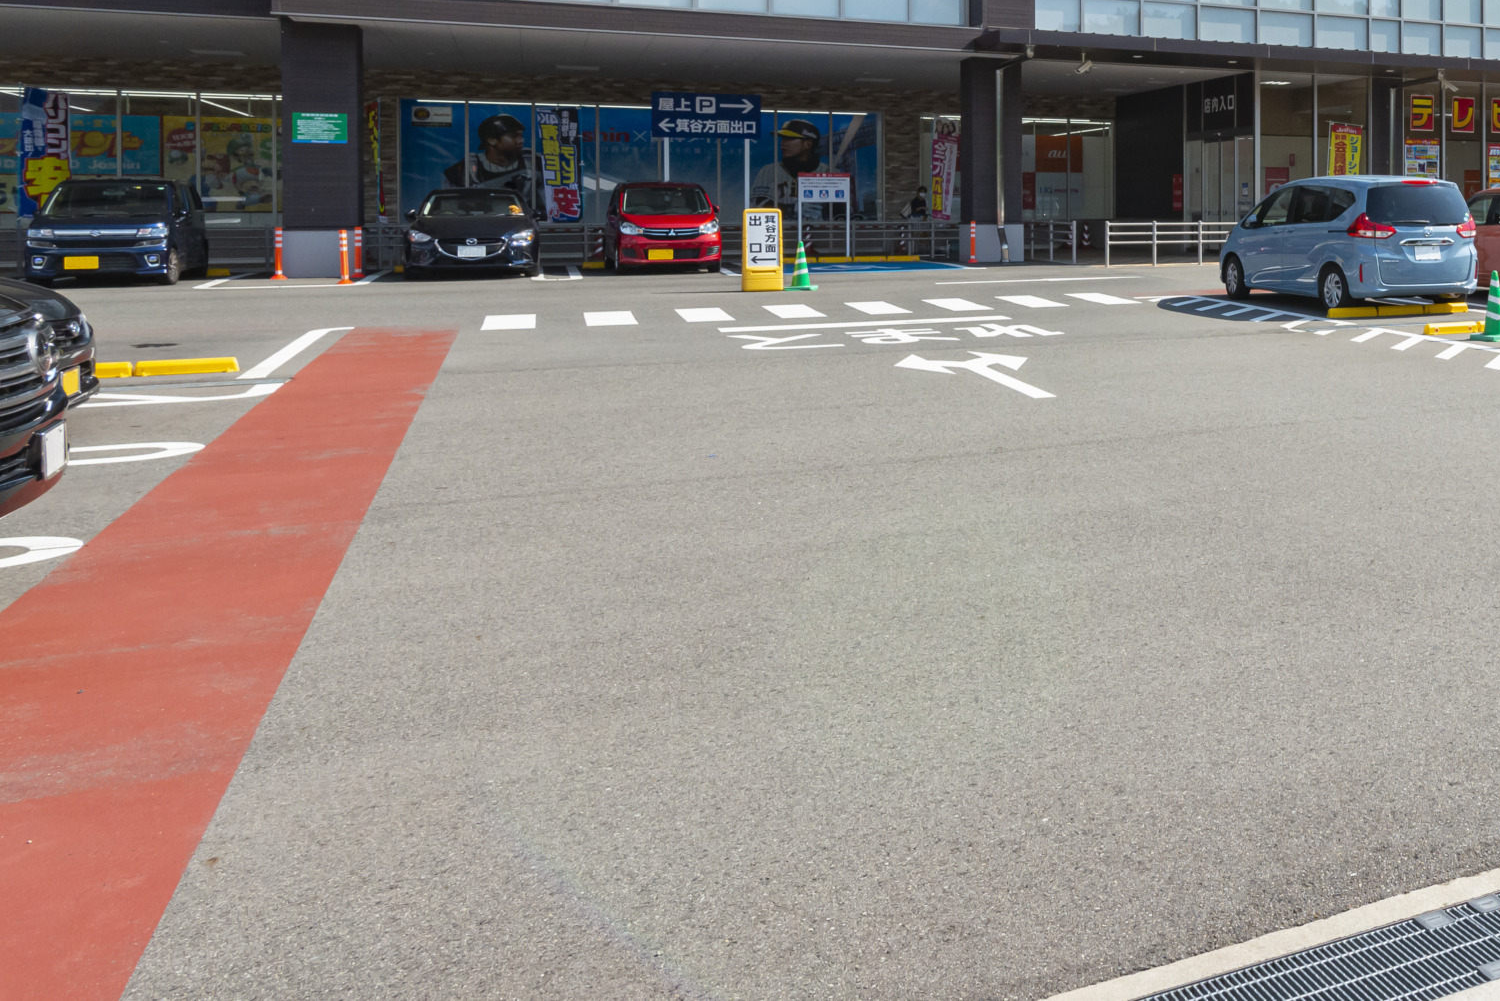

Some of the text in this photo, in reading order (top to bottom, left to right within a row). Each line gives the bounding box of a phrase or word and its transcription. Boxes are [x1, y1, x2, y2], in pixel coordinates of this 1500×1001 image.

[658, 97, 691, 112] 屋上
[1204, 94, 1235, 114] 店内入口
[185, 121, 228, 132] SPER
[675, 120, 757, 134] 箕谷方面出口
[1048, 150, 1068, 158] au
[749, 215, 762, 253] 出口
[764, 215, 776, 253] 箕谷方面
[726, 323, 1065, 350] とまれ
